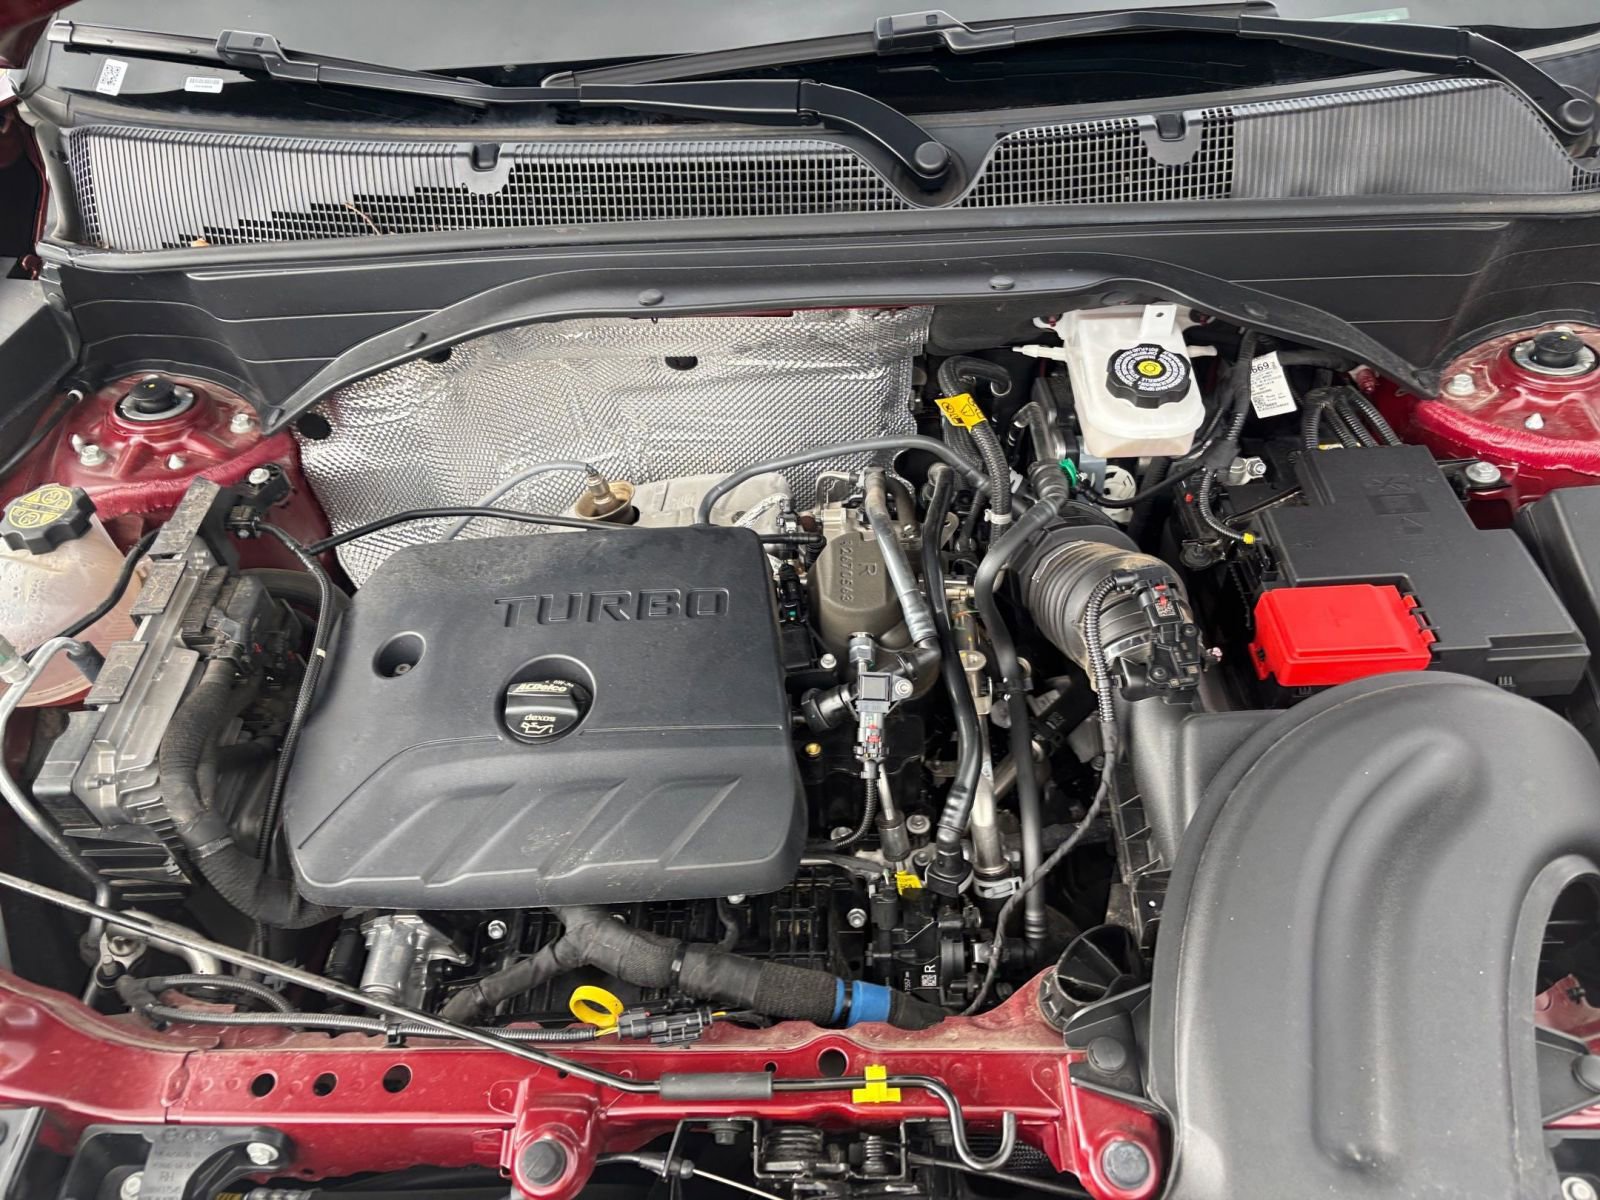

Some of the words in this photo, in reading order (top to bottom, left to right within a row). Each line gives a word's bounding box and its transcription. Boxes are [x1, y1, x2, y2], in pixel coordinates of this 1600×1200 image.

[494, 587, 730, 628] TURBO
[512, 682, 568, 693] ACDelco
[524, 713, 557, 722] dexos
[924, 964, 936, 973] R
